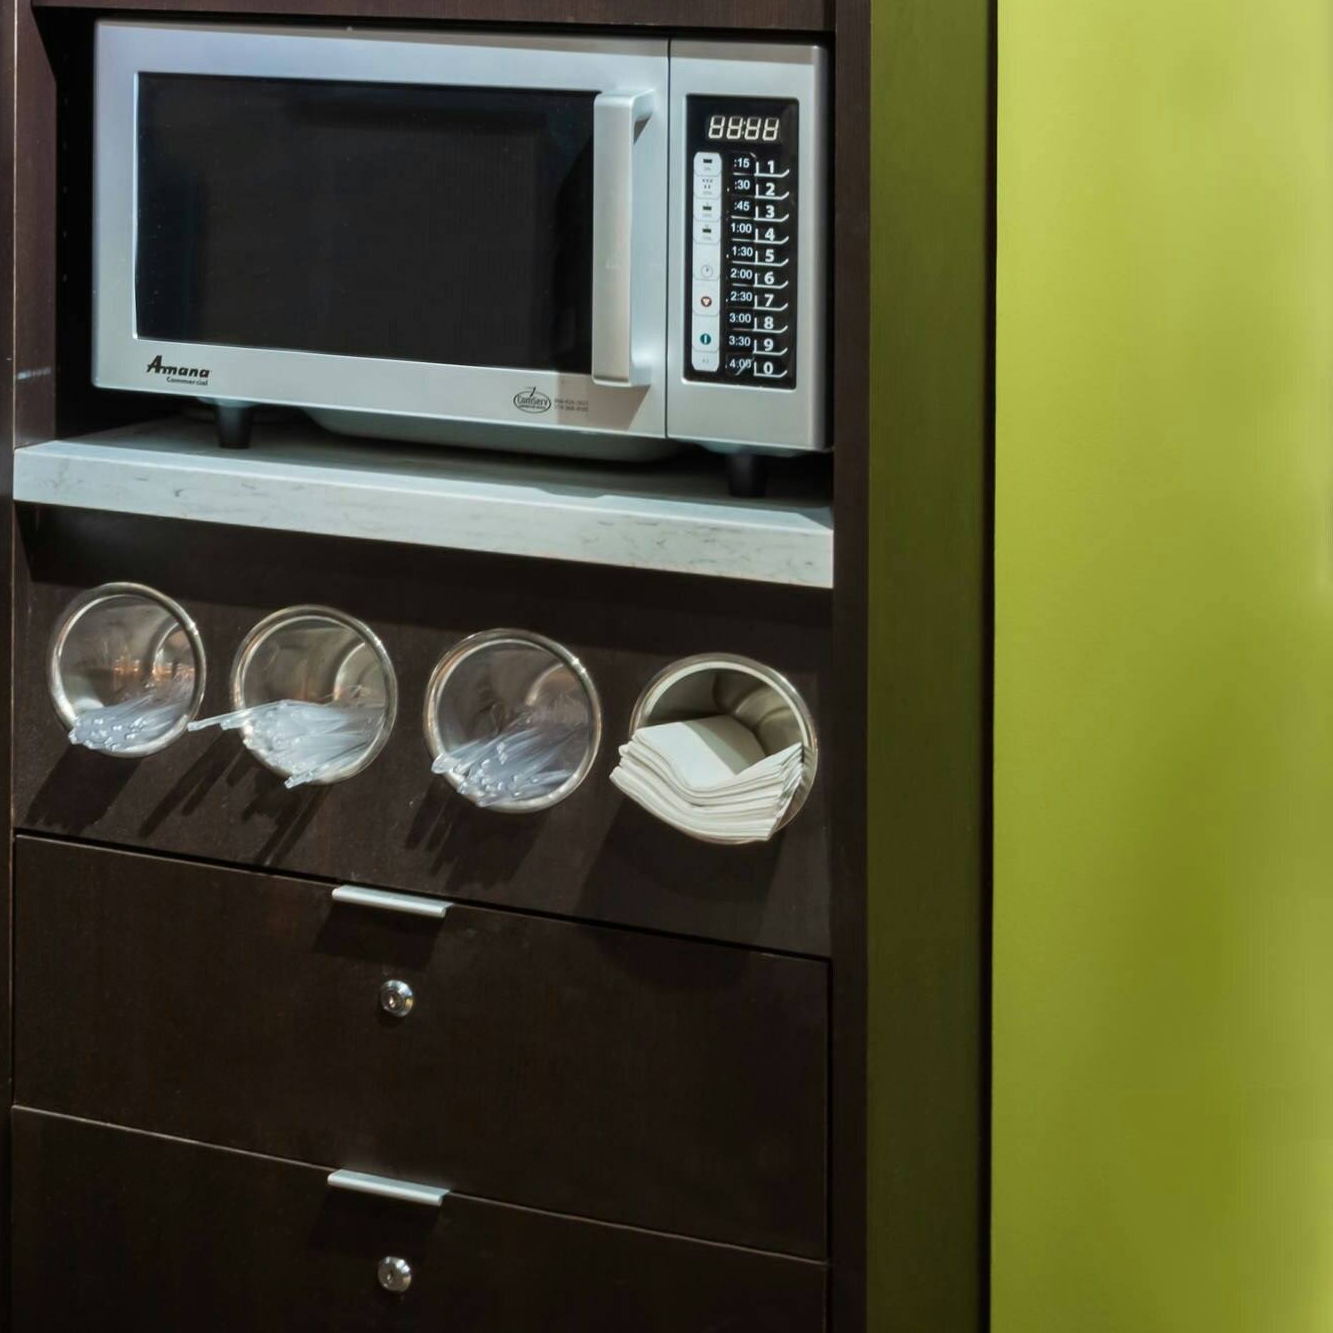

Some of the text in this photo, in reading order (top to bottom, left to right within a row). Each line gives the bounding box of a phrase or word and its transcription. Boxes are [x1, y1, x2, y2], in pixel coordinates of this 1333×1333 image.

[734, 157, 775, 174] :15 1
[734, 179, 775, 196] :30 2
[734, 201, 775, 219] :45 3
[730, 223, 775, 241] 1:00 4
[731, 246, 774, 263] 1:30 5
[730, 269, 775, 285] 2:00 6
[730, 291, 774, 307] 2:30 7
[729, 313, 774, 330] 3:00 8
[728, 335, 774, 352] 3:30 9
[146, 354, 211, 379] Amana
[729, 358, 774, 375] 4:00 0
[165, 376, 209, 387] Commercial
